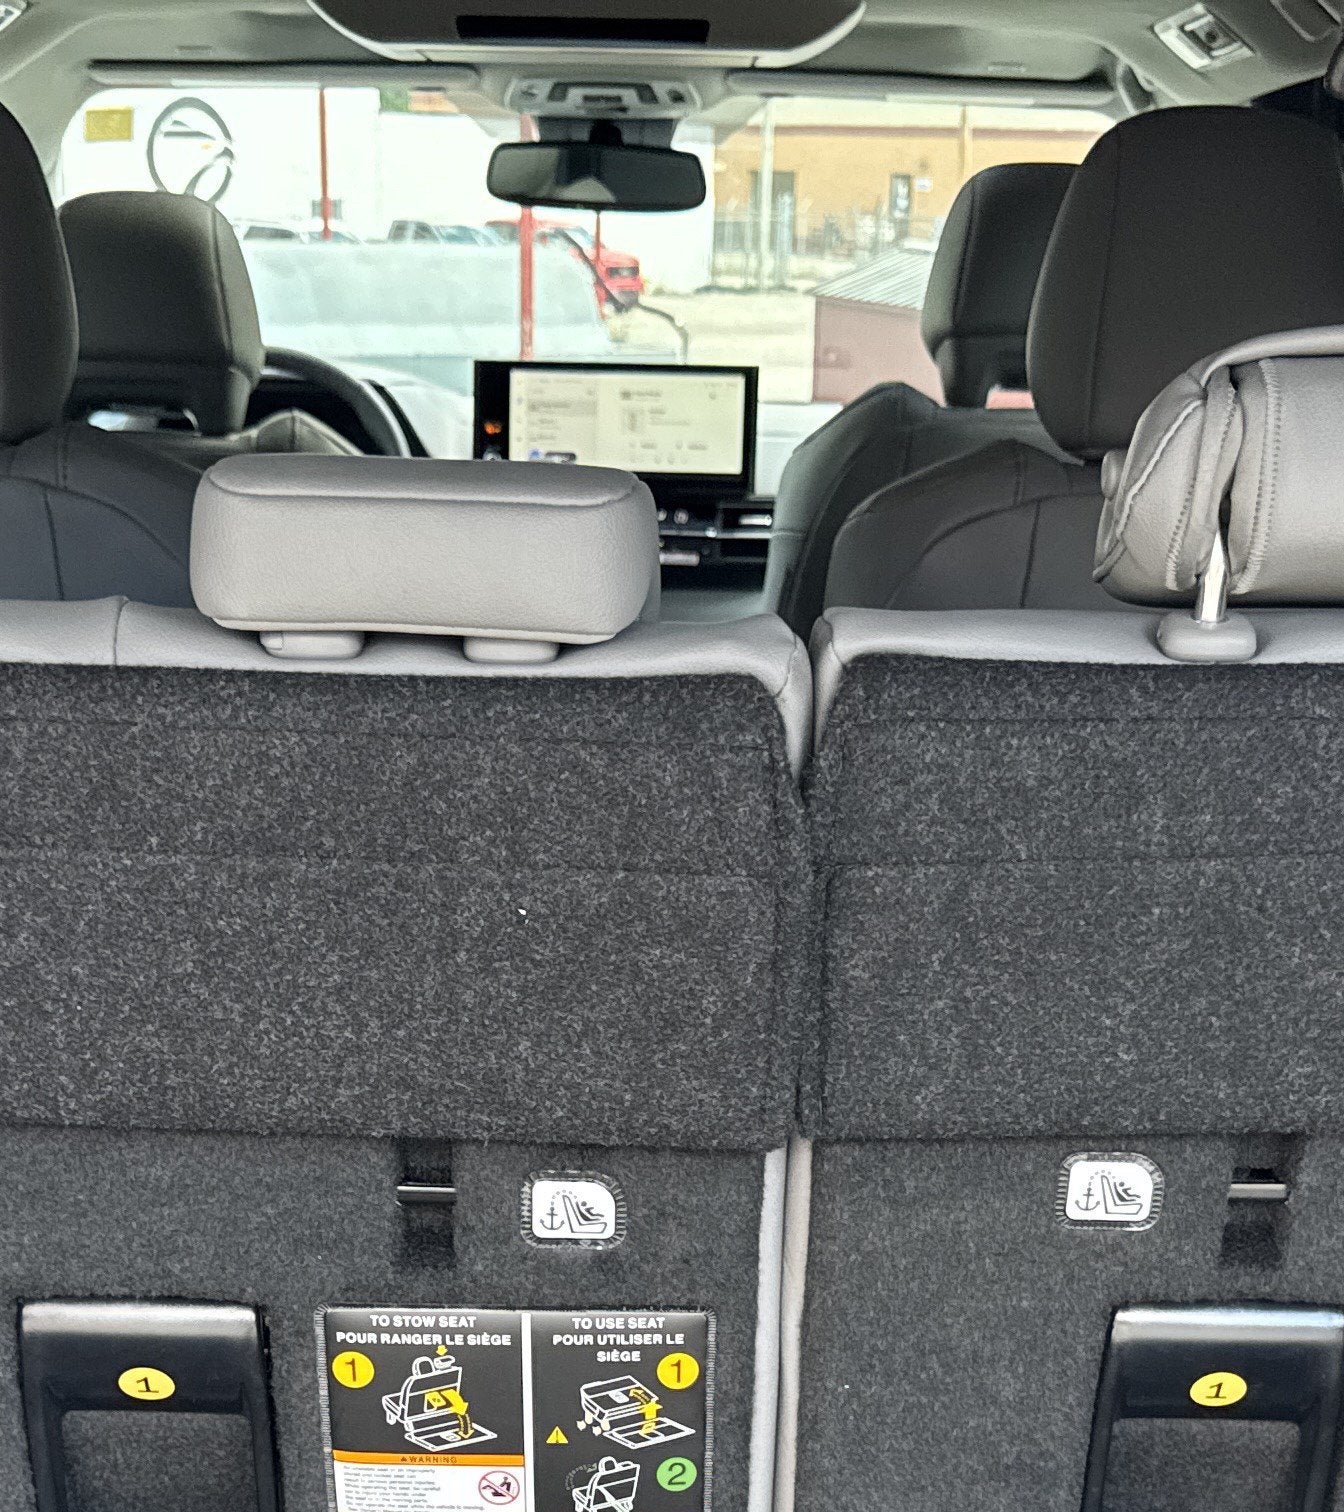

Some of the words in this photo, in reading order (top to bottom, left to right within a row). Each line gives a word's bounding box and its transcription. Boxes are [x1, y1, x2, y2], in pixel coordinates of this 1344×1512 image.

[369, 1314, 391, 1327] TO
[393, 1315, 436, 1328] STOW
[438, 1315, 477, 1328] SEAT
[572, 1317, 593, 1330] TO
[595, 1317, 625, 1330] USE
[627, 1317, 666, 1329] SEAT
[336, 1331, 378, 1344] POUR
[380, 1333, 443, 1345] RANGER
[445, 1334, 464, 1346] LE
[467, 1331, 512, 1346] SIÈGE
[552, 1334, 594, 1346] POUR
[597, 1333, 663, 1346] UTILISER
[666, 1333, 685, 1345] LE
[596, 1349, 641, 1363] SIÈGE
[345, 1358, 357, 1382] 1
[670, 1359, 682, 1384] 1
[136, 1376, 159, 1393] 1
[1205, 1382, 1227, 1399] 1
[409, 1456, 458, 1464] WARNING
[667, 1462, 687, 1486] 2
